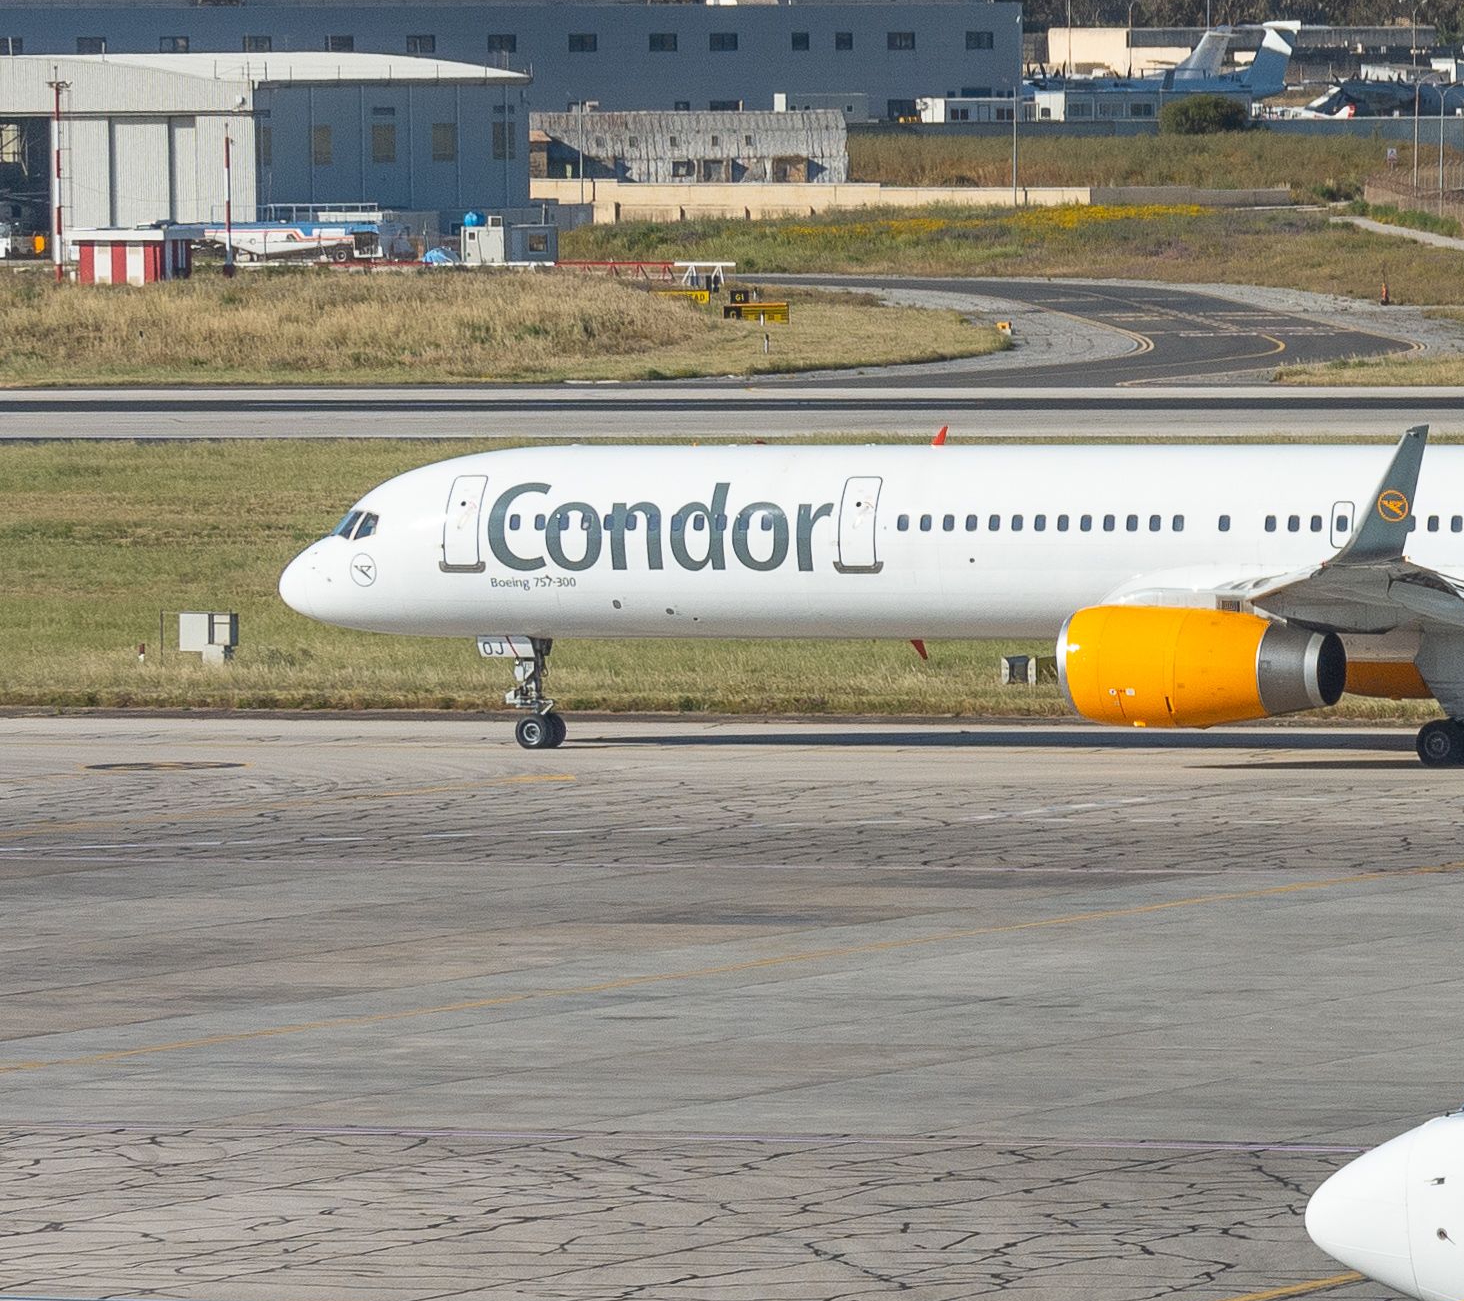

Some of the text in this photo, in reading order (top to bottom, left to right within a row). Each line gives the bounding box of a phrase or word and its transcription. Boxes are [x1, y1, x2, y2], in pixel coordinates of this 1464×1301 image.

[487, 482, 833, 573] Condor
[490, 576, 577, 591] Boeing 757-300
